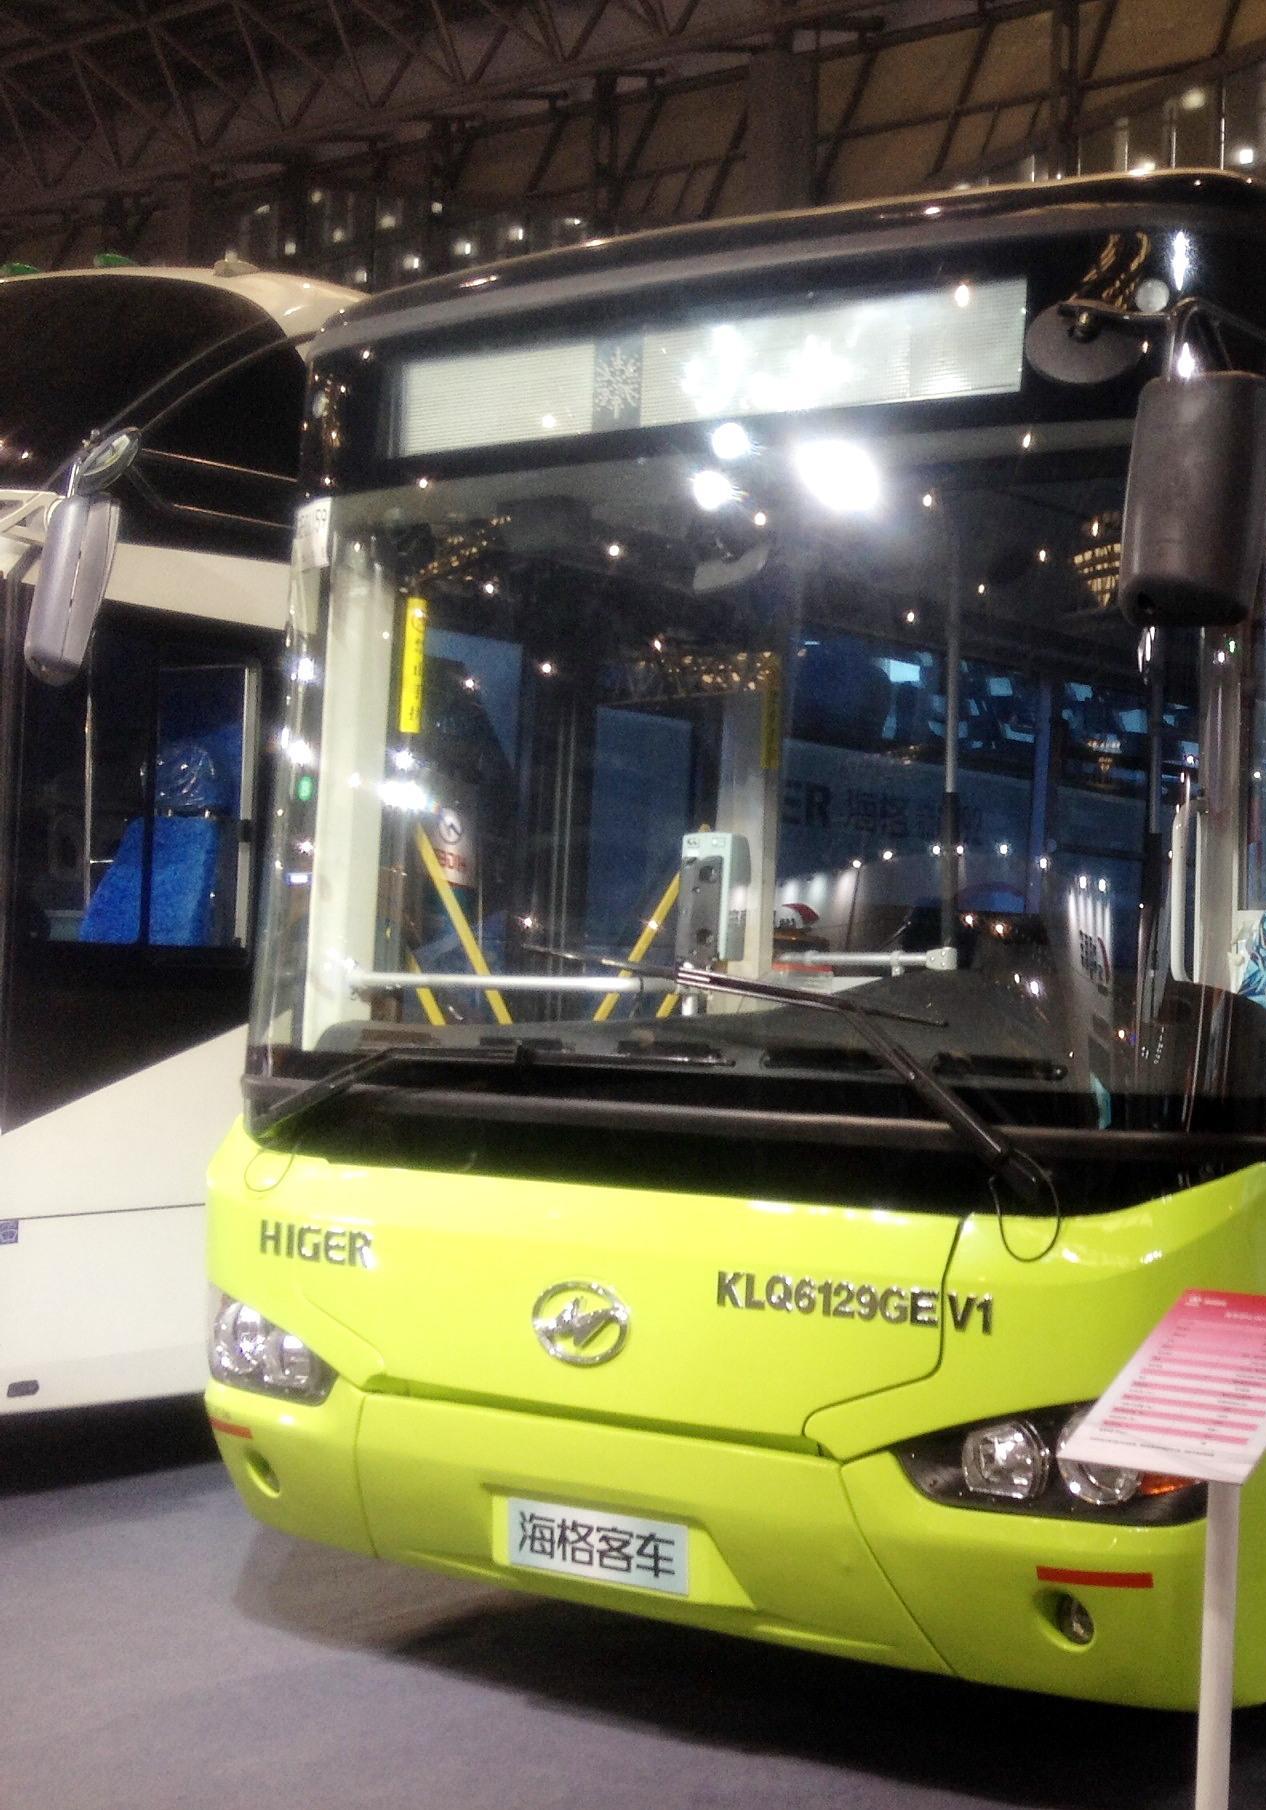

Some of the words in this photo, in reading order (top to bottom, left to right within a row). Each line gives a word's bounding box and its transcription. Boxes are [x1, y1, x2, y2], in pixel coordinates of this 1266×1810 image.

[260, 1219, 372, 1269] HIGER
[518, 1510, 676, 1579] 海格客车
